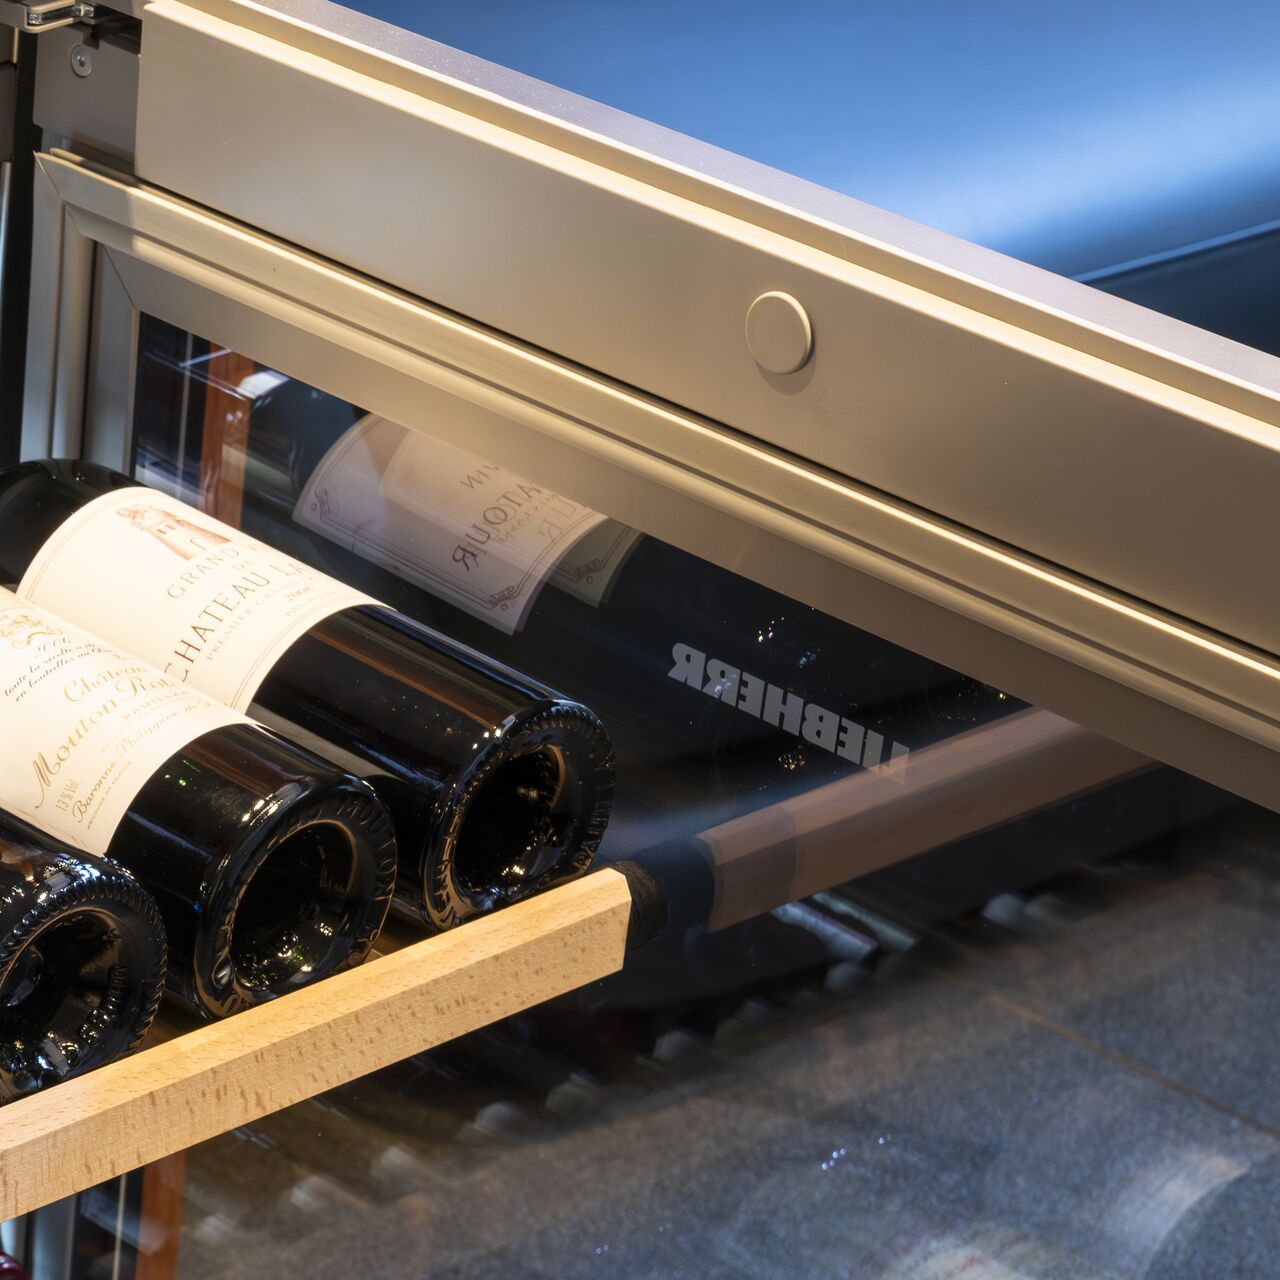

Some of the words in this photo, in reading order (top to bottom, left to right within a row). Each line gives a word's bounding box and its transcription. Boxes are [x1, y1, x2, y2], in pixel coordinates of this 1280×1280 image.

[167, 549, 239, 598] GRAND
[269, 562, 305, 576] LA
[35, 699, 119, 809] Mouton
[72, 761, 117, 823] Baronne
